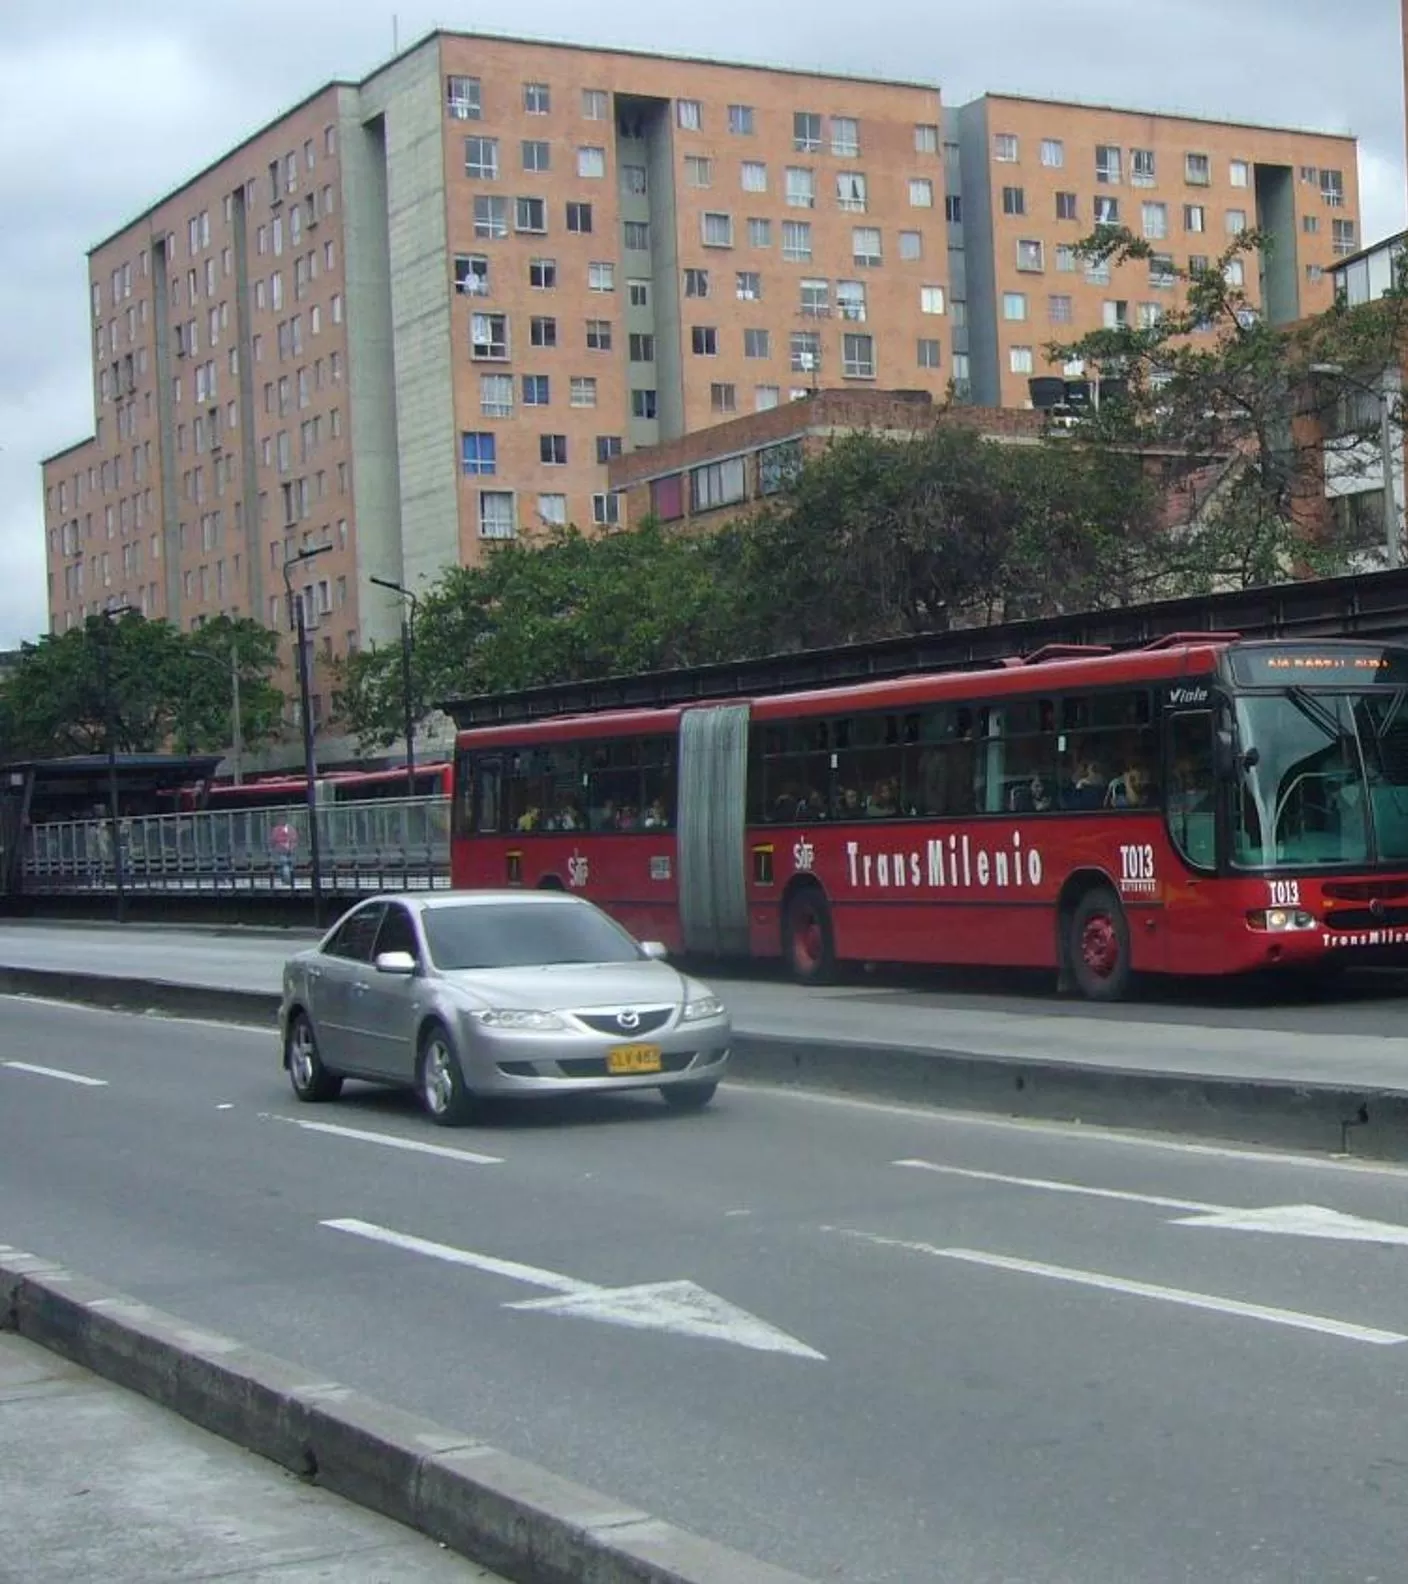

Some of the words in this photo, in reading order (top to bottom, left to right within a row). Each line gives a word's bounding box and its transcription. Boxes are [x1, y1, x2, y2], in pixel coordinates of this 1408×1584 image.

[847, 829, 1043, 887] TransMilenio
[1119, 844, 1154, 879] T013
[1269, 879, 1300, 904] T013
